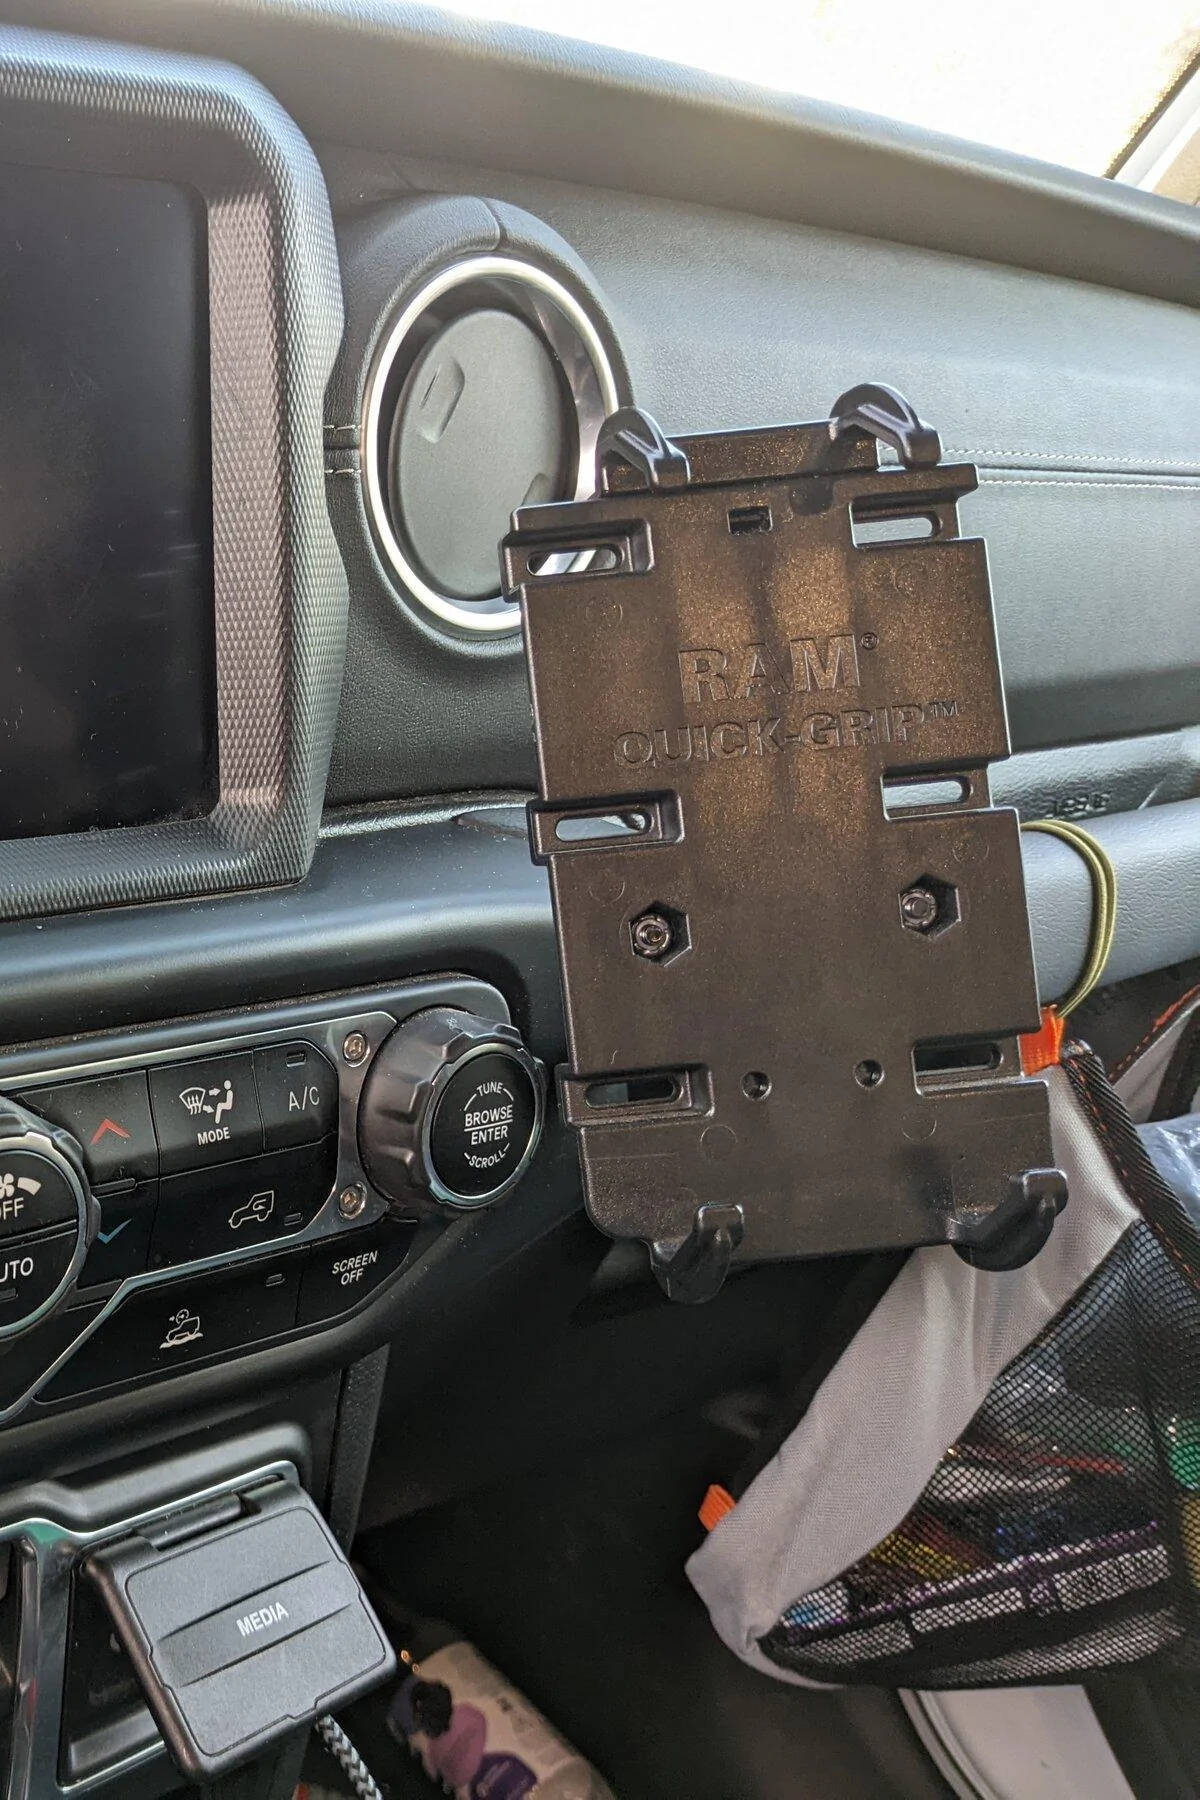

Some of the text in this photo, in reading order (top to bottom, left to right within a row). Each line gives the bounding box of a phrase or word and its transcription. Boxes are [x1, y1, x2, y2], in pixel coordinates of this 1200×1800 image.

[288, 1086, 320, 1111] A/C
[477, 1081, 504, 1097] TUNE
[464, 1104, 514, 1128] BROWSE
[197, 1126, 231, 1146] MODE
[470, 1125, 509, 1146] ENTER
[468, 1150, 506, 1169] SCROLL
[331, 1250, 378, 1275] SCREEN
[340, 1267, 364, 1286] OFF
[236, 1601, 289, 1638] MEDIA
